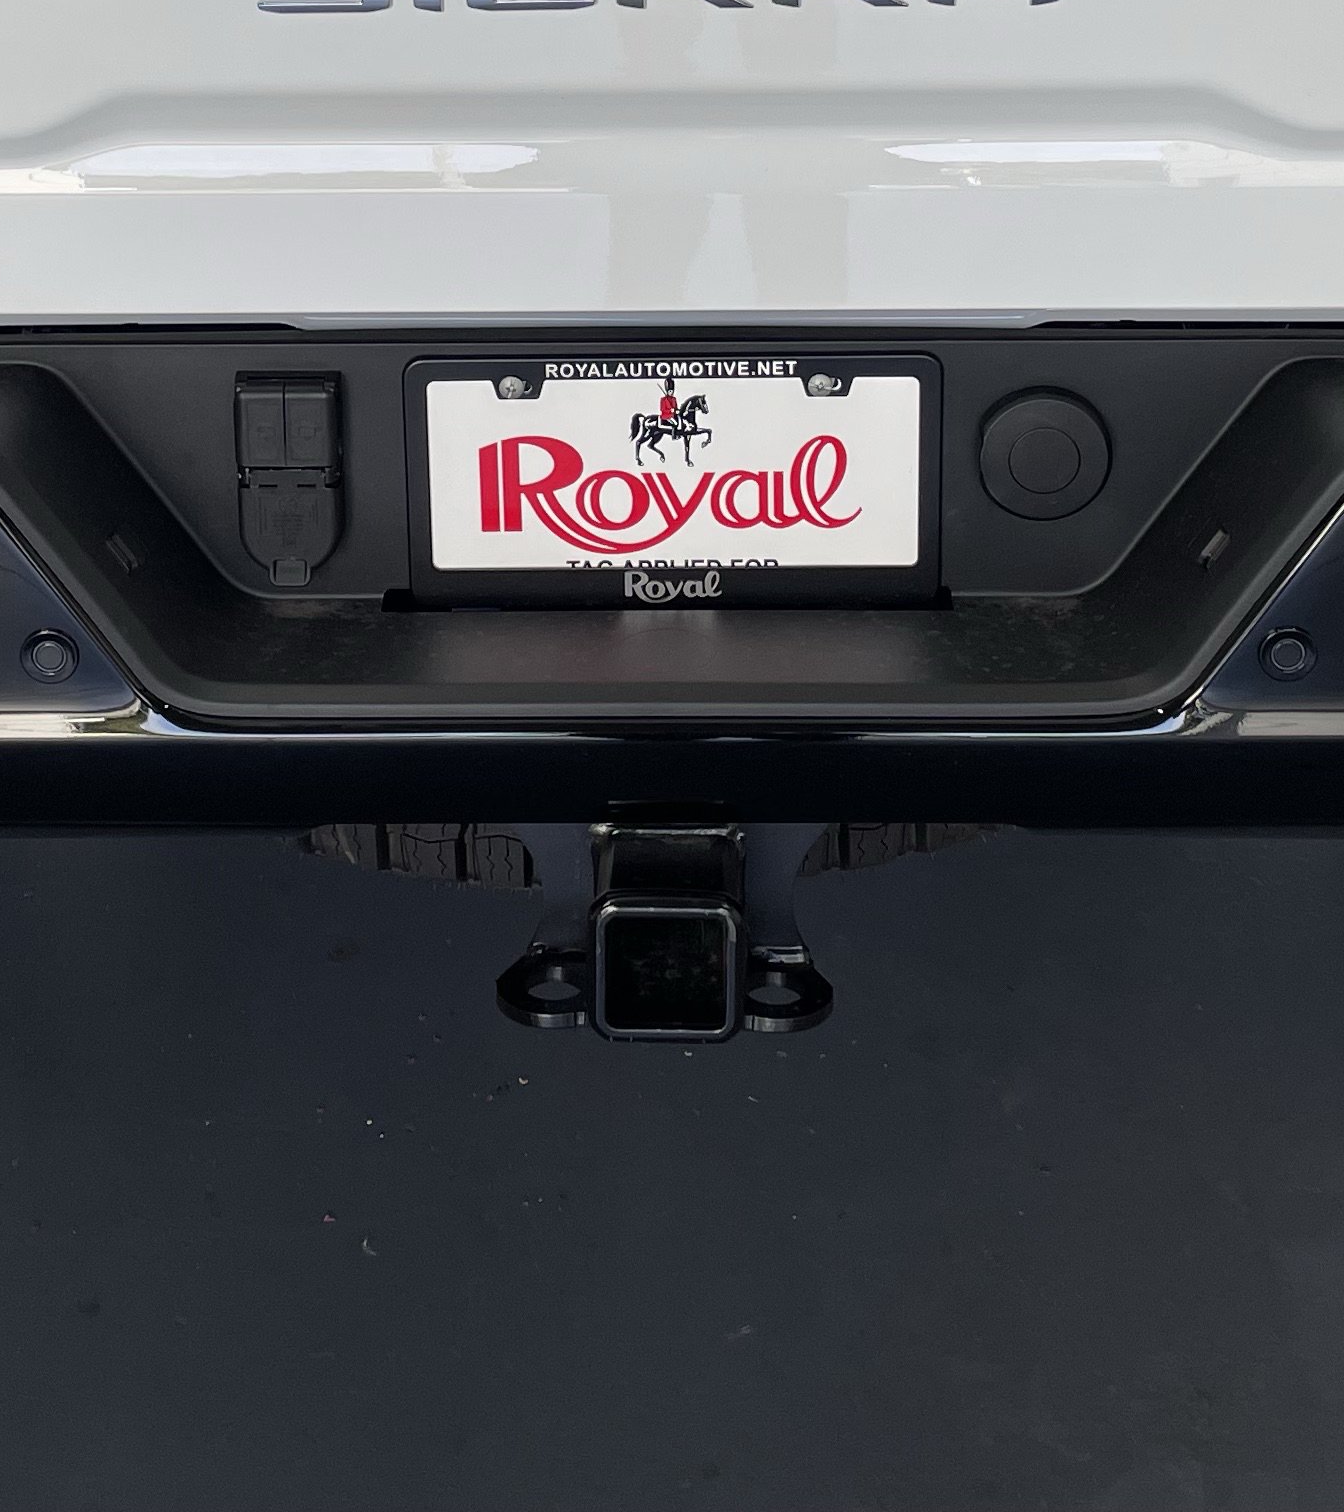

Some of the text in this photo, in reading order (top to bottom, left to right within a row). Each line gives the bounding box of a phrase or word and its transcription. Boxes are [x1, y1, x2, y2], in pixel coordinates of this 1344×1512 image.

[545, 360, 798, 378] ROYALAUTOMOTIVE.NET
[478, 434, 862, 554] Royal
[624, 570, 723, 604] Royal
